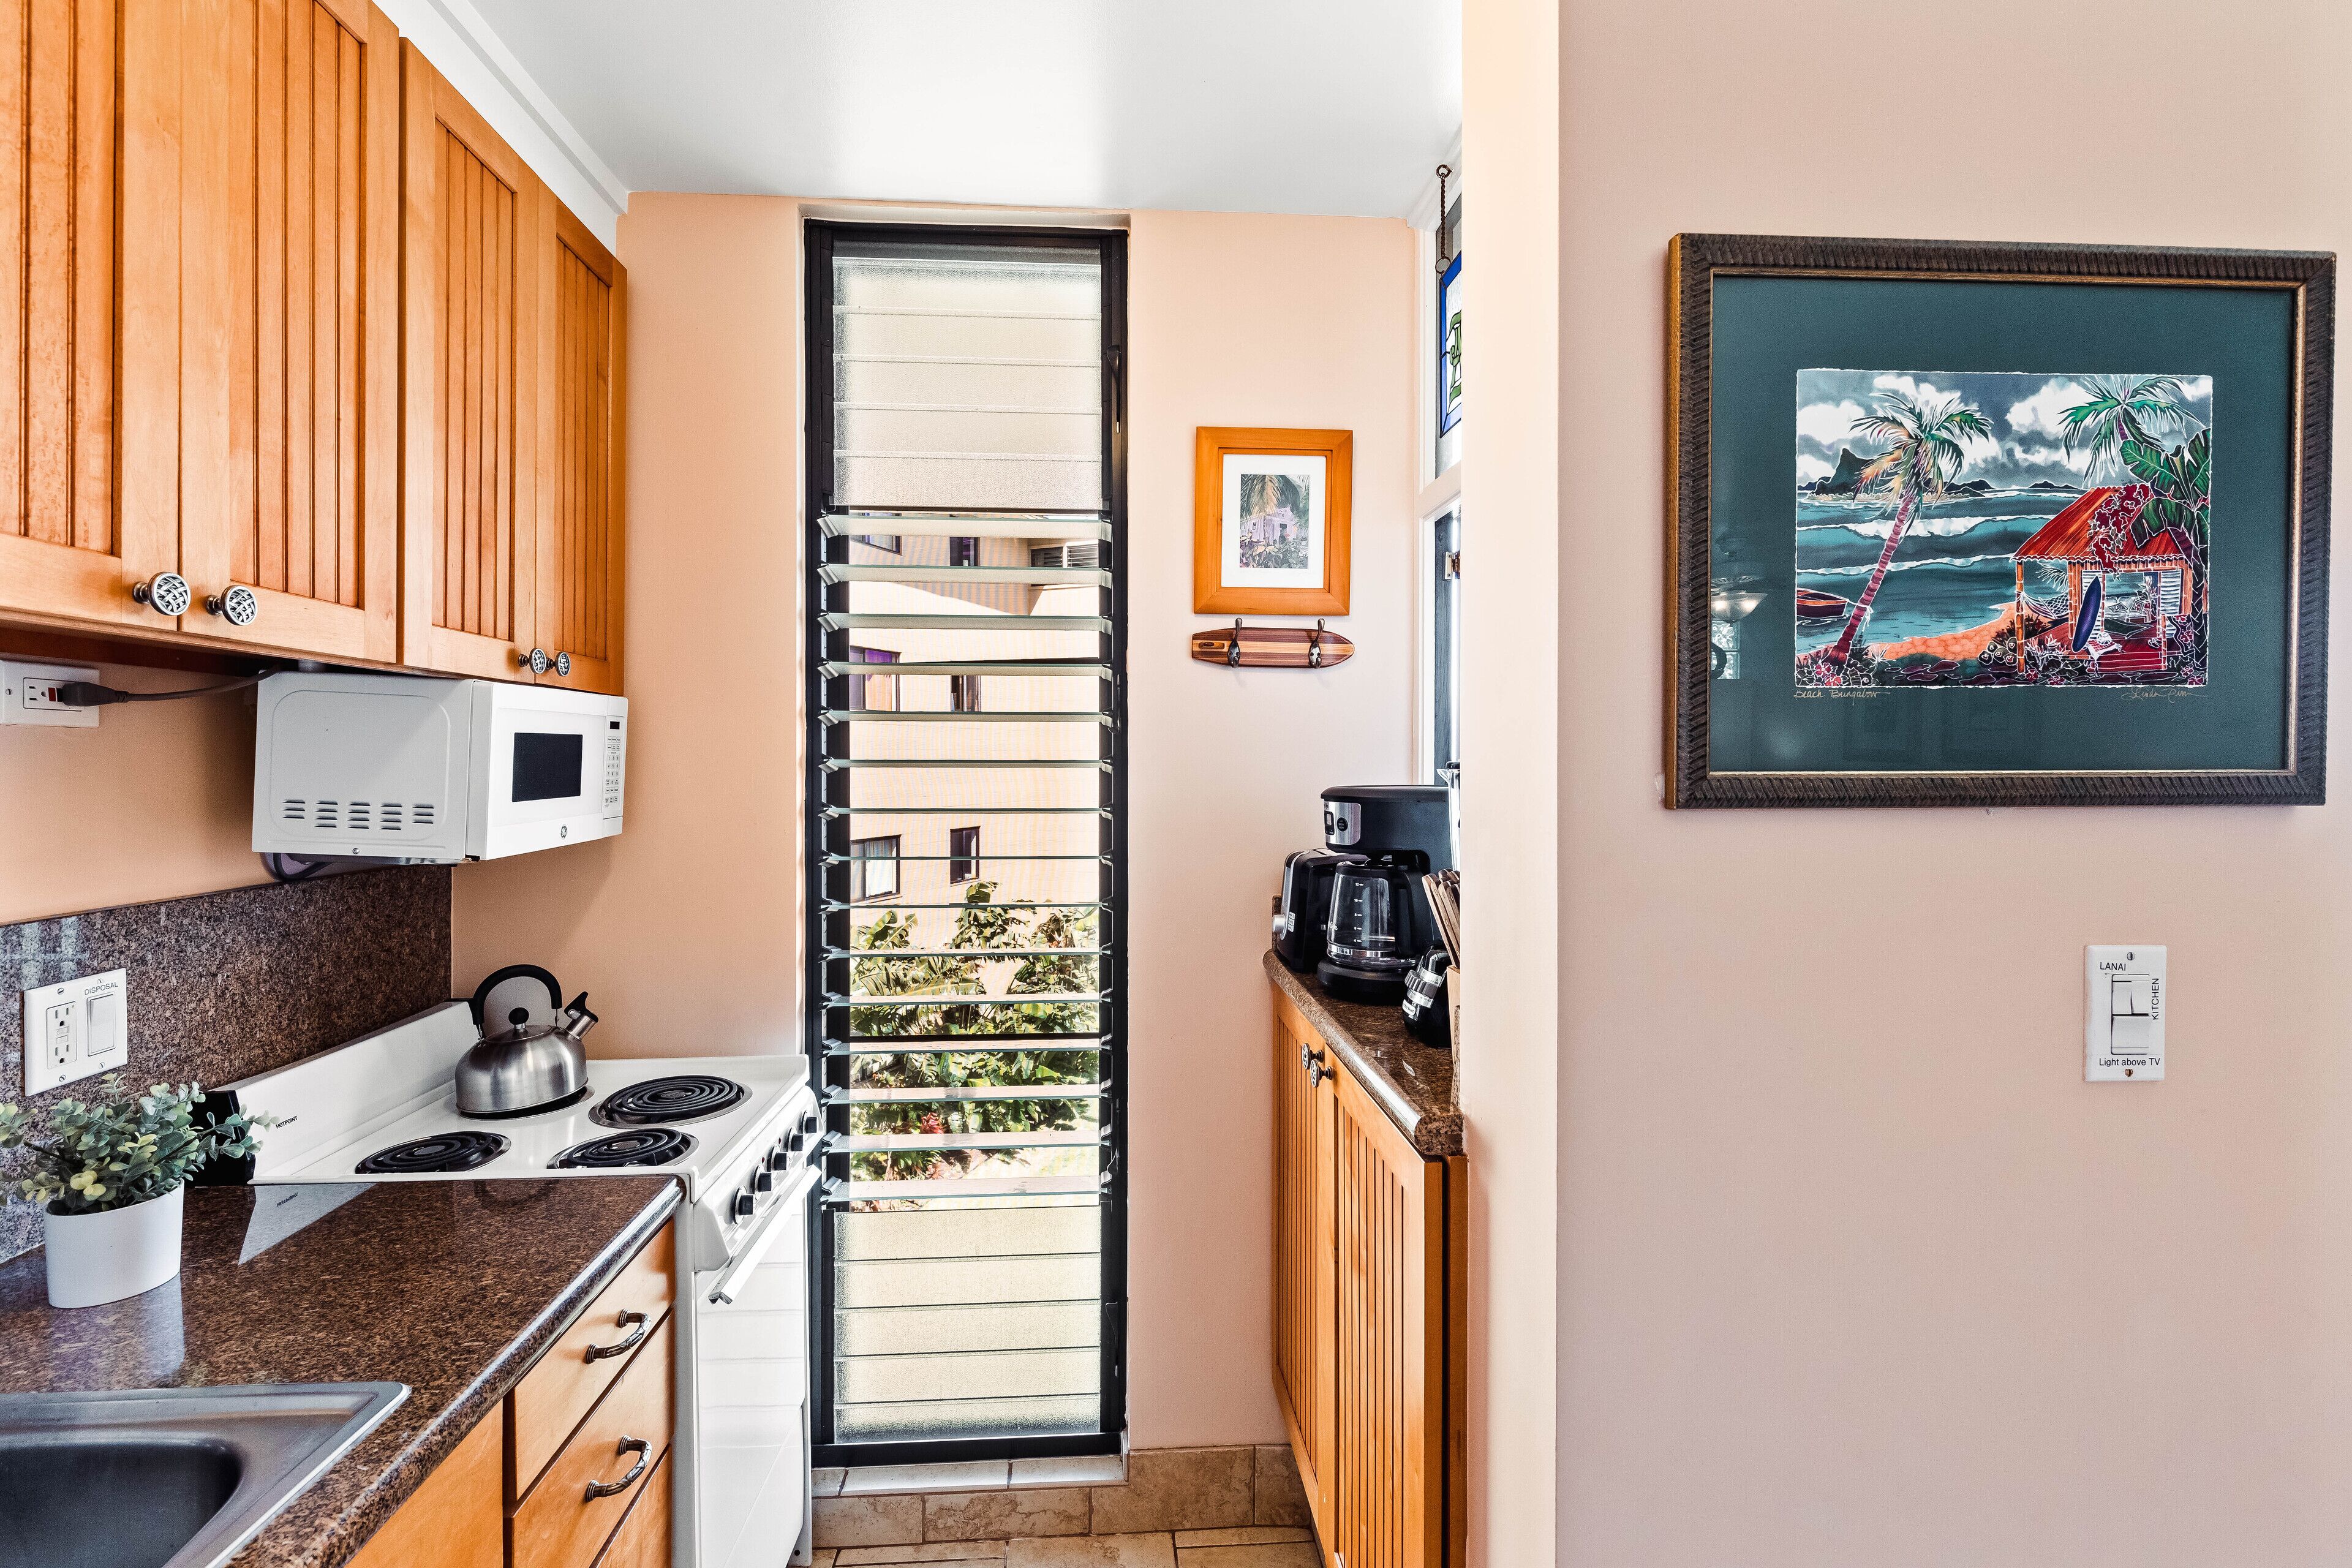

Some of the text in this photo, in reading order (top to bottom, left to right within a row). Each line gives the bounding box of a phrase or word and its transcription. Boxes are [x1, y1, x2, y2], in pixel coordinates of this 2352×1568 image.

[1793, 688, 1890, 706] Beach Bungalow
[2100, 962, 2126, 971] LANAI
[85, 982, 118, 995] DISPOSAL
[2099, 1058, 2119, 1067] Light
[276, 1115, 298, 1129] HOTPOINT
